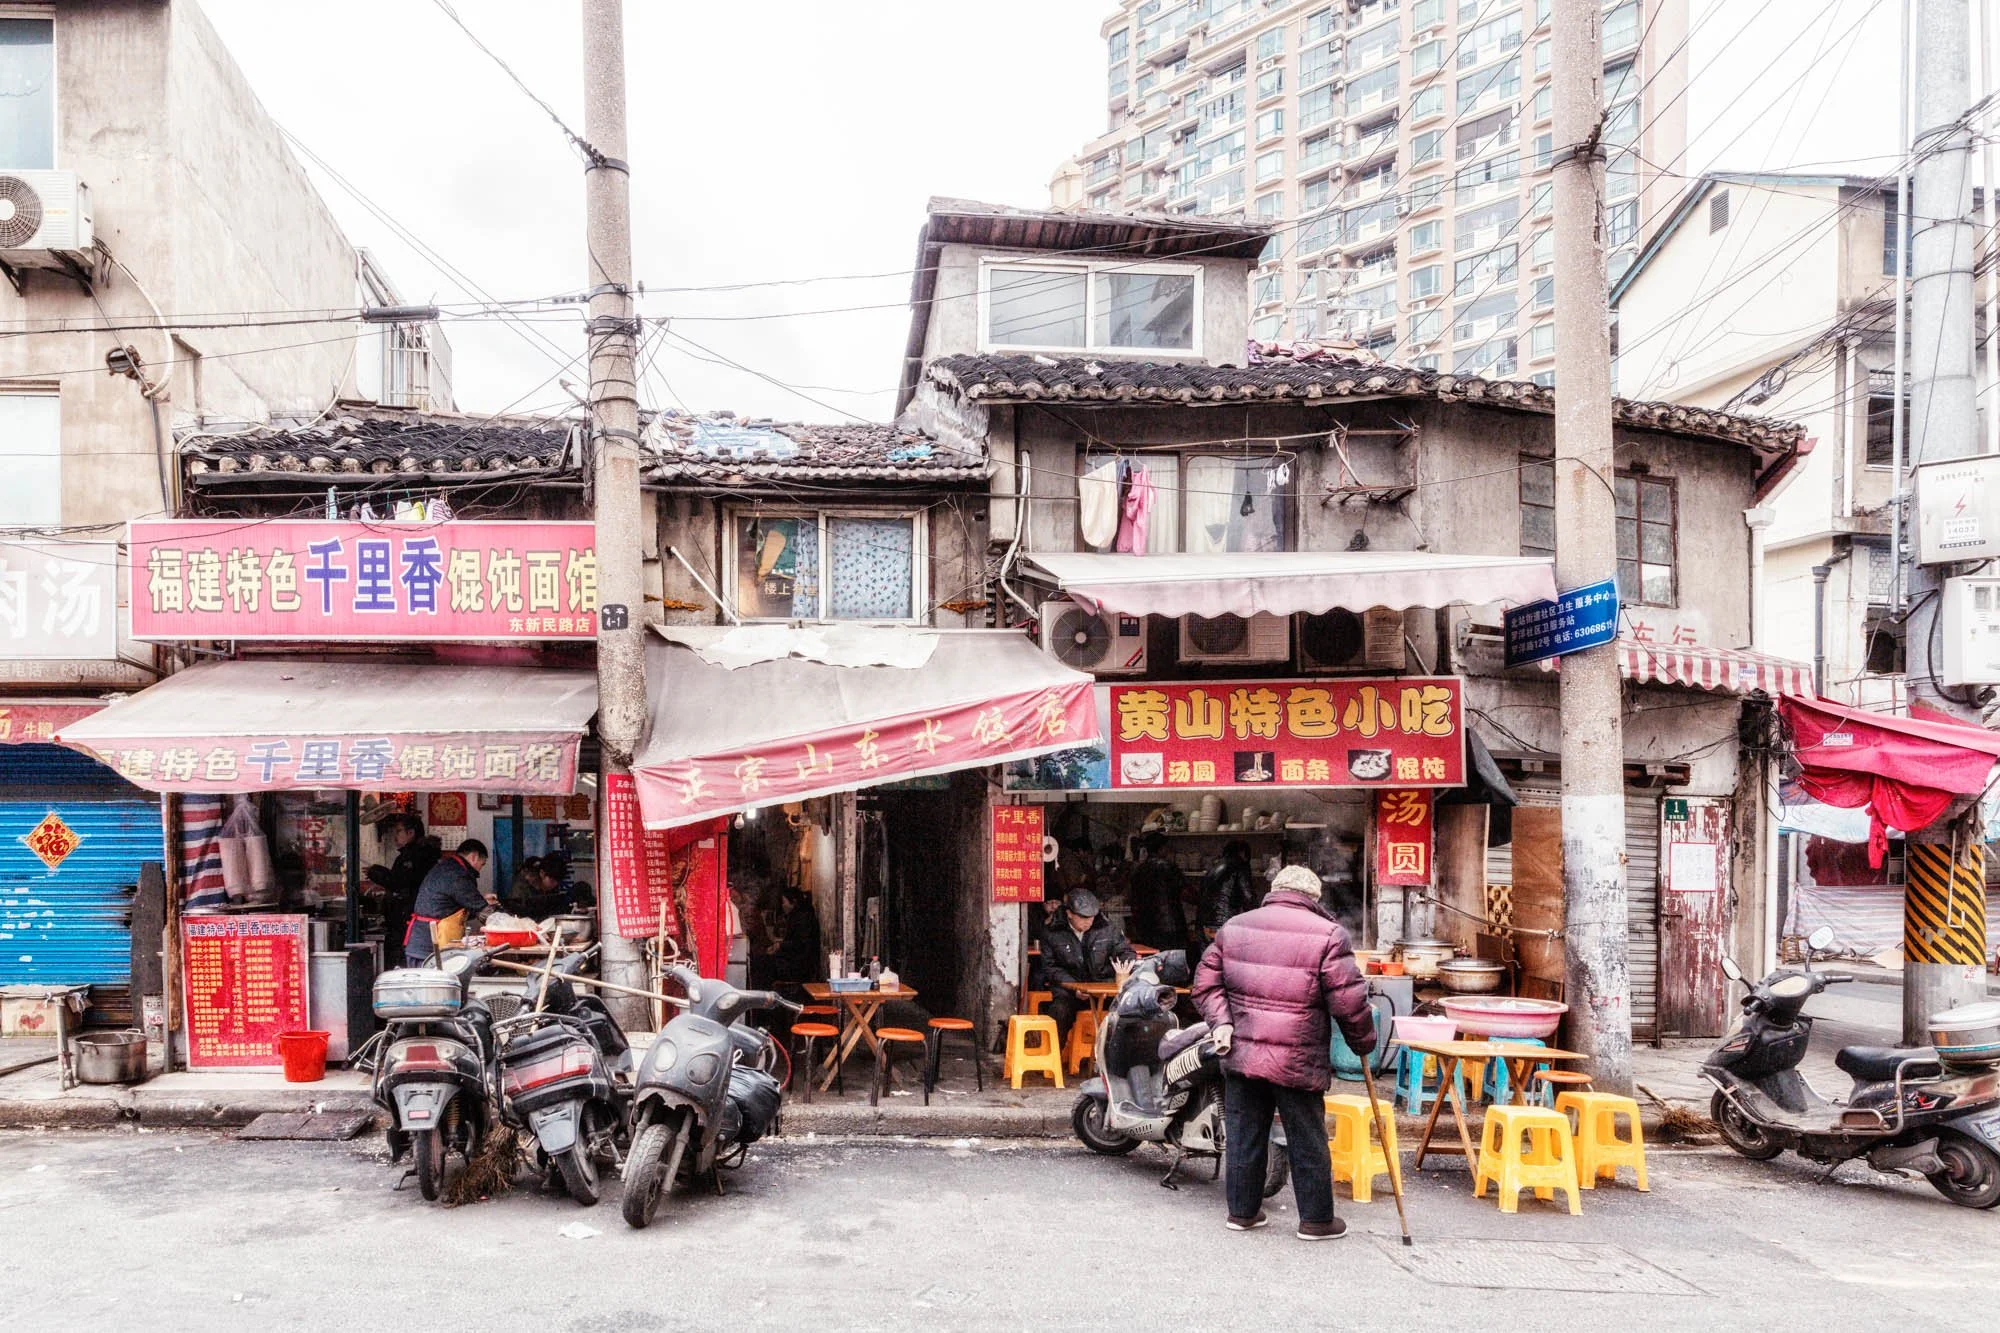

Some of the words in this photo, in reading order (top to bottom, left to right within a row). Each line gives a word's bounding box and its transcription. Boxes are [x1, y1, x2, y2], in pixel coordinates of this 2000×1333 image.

[148, 536, 597, 616] 福建特色千里香馄饨面馆
[508, 617, 591, 633] 东新民路店
[1117, 685, 1454, 742] 黄山特色小吃
[98, 739, 562, 784] 建特色千里香馄饨面馆
[679, 693, 1070, 805] 正宗山东水饺店
[1168, 760, 1216, 783] 汤圆
[1280, 758, 1330, 782] 面条
[1396, 757, 1446, 780] 馄饨
[997, 809, 1040, 824] 千里香
[1381, 791, 1428, 876] 汤圆
